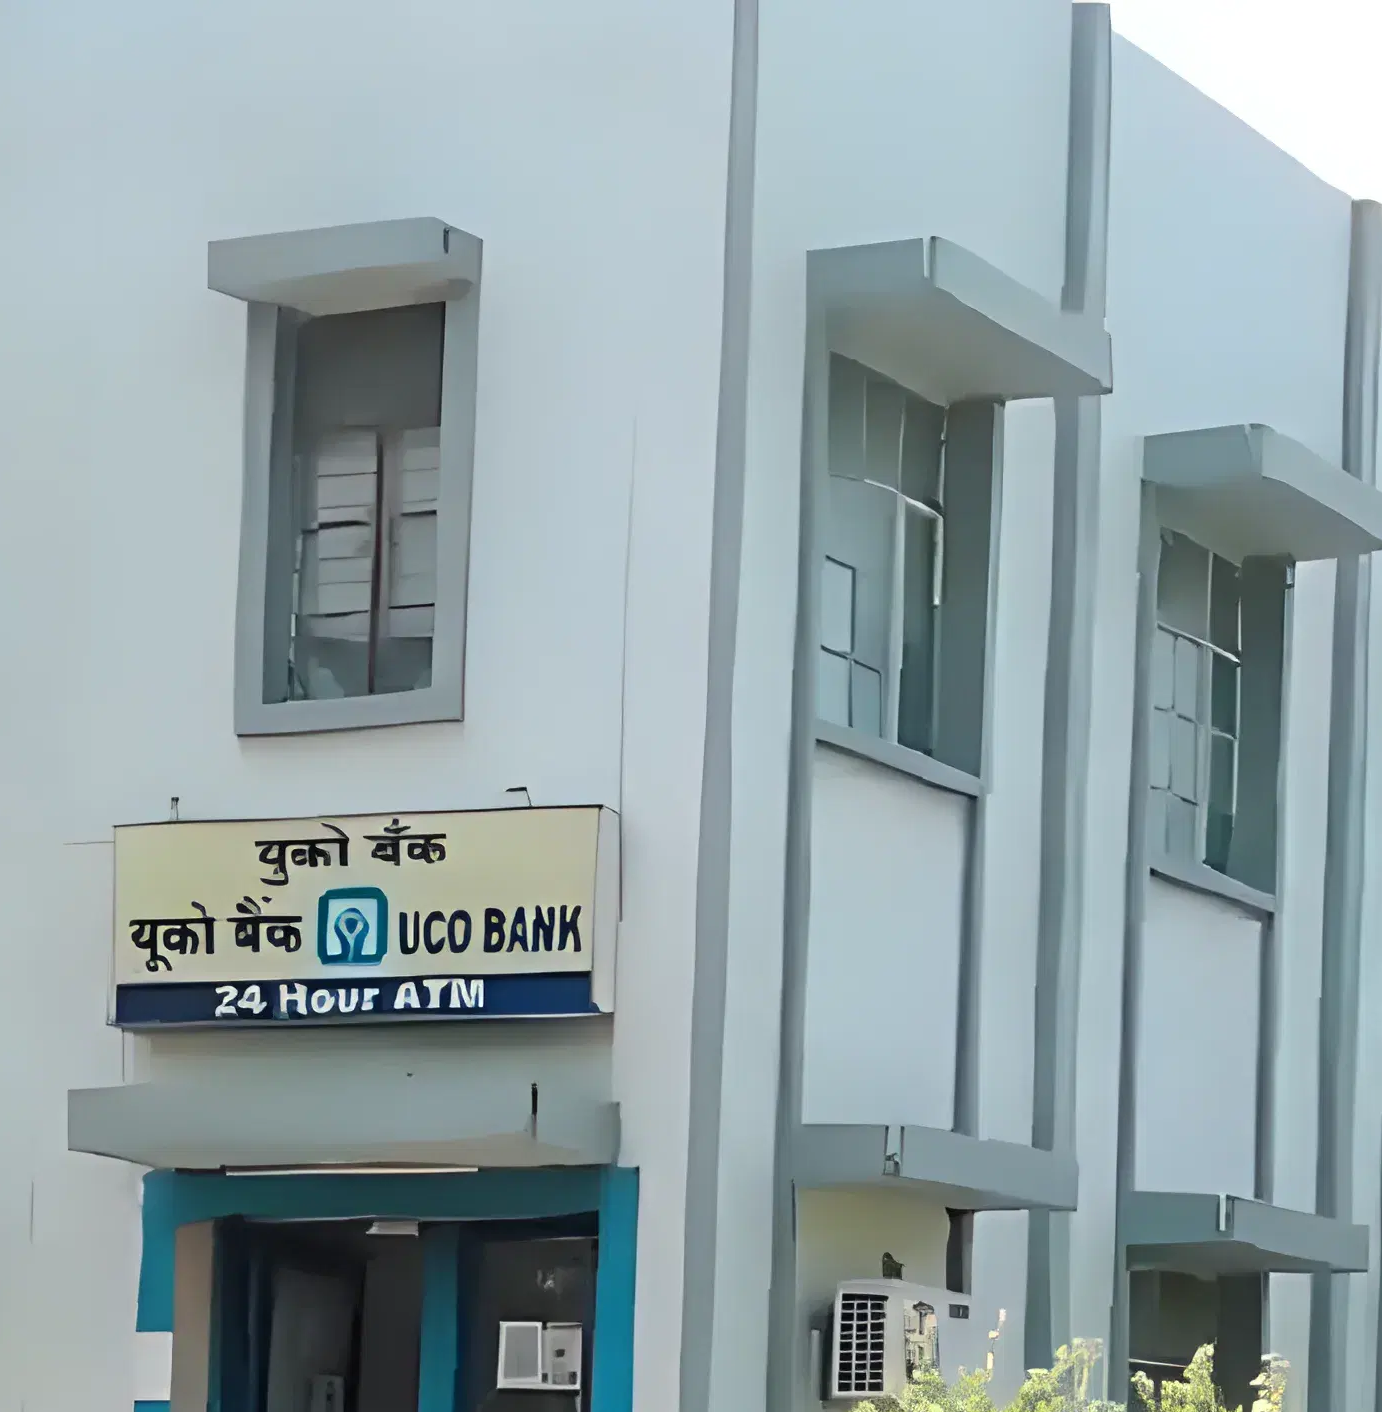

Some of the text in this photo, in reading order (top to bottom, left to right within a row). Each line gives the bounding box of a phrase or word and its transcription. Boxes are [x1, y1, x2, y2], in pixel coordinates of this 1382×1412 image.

[129, 896, 302, 972] यूको बैंक
[399, 905, 582, 954] UCO BANK
[215, 978, 484, 1017] 24 Hour ATM
